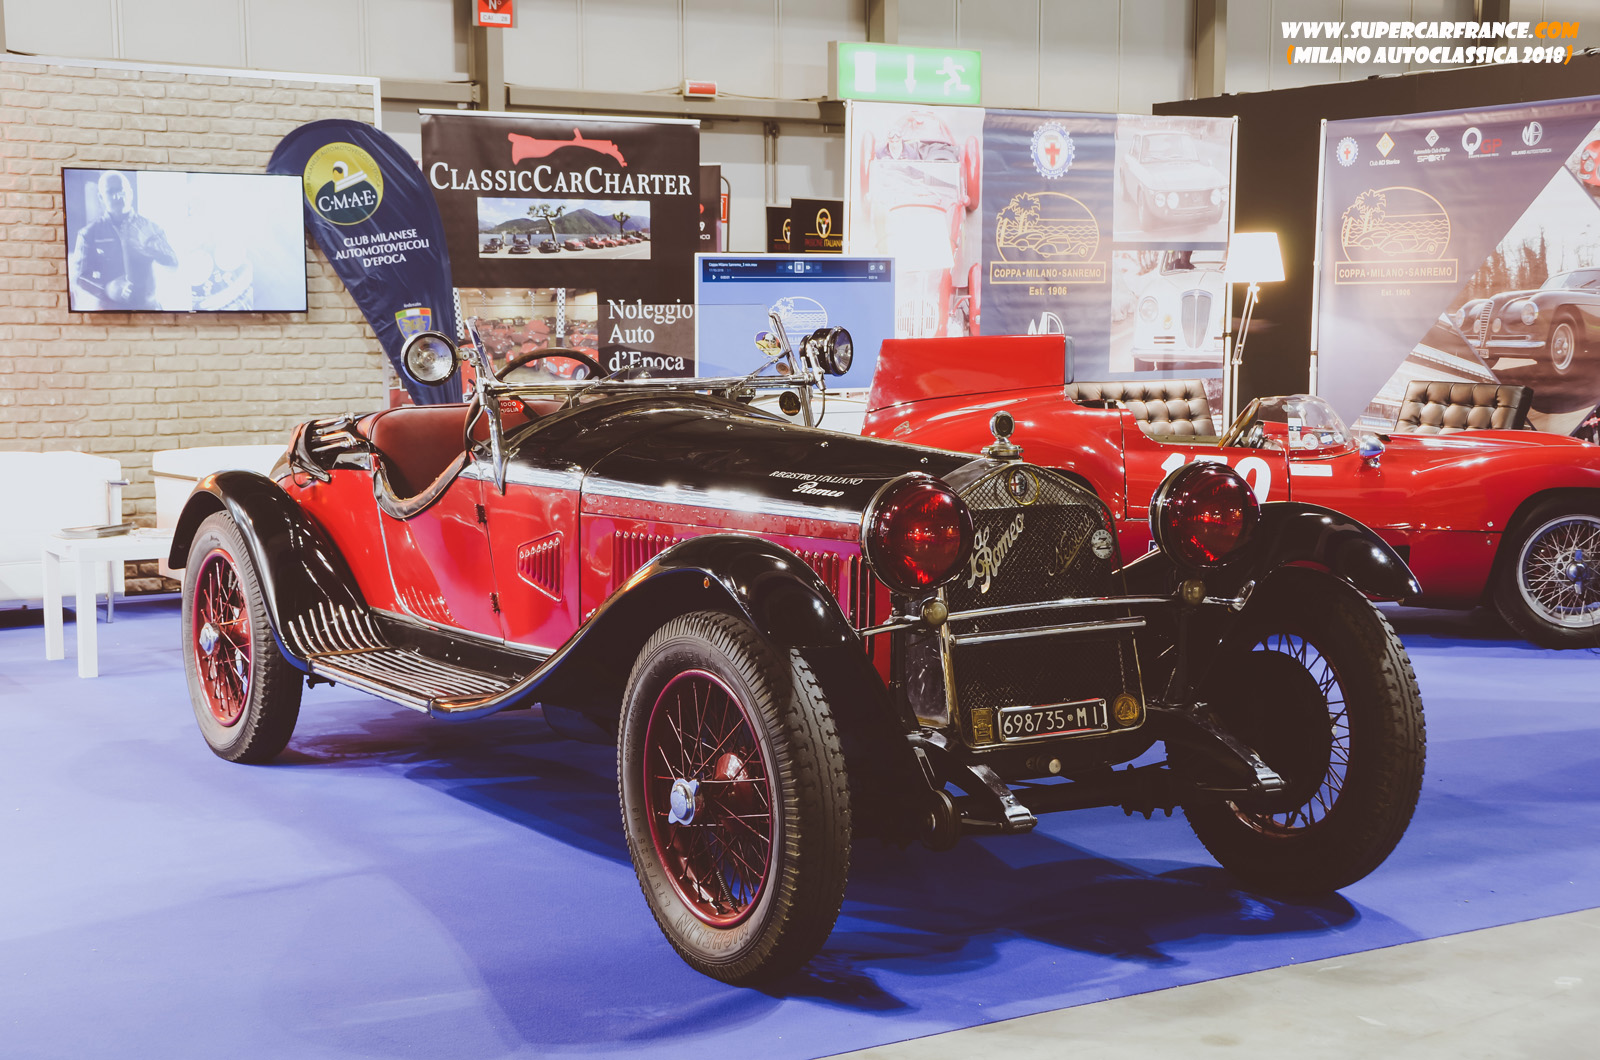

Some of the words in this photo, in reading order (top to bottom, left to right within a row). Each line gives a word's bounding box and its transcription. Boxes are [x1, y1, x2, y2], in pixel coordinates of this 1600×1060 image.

[343, 234, 369, 248] CLUB
[370, 228, 418, 244] MILANESE
[335, 238, 430, 260] AUTOMOTOVEICOLI
[362, 253, 407, 268] D'EPOCA
[993, 268, 1021, 278] COPPA
[1026, 268, 1058, 278] MILANO
[1062, 268, 1102, 278] SANREMO
[1339, 269, 1366, 278] COPPA
[1370, 268, 1403, 278] MILANO
[1408, 267, 1452, 277] SANREMO
[1029, 286, 1045, 295] Est.
[1047, 286, 1067, 295] 1906
[607, 298, 693, 325] Noleggio
[608, 323, 655, 344] Auto
[769, 470, 816, 481] REGISTRO
[814, 474, 864, 486] ITALIANO
[792, 481, 845, 498] Romeo
[1003, 709, 1065, 735] 698735
[675, 912, 749, 950] MICHELIN
